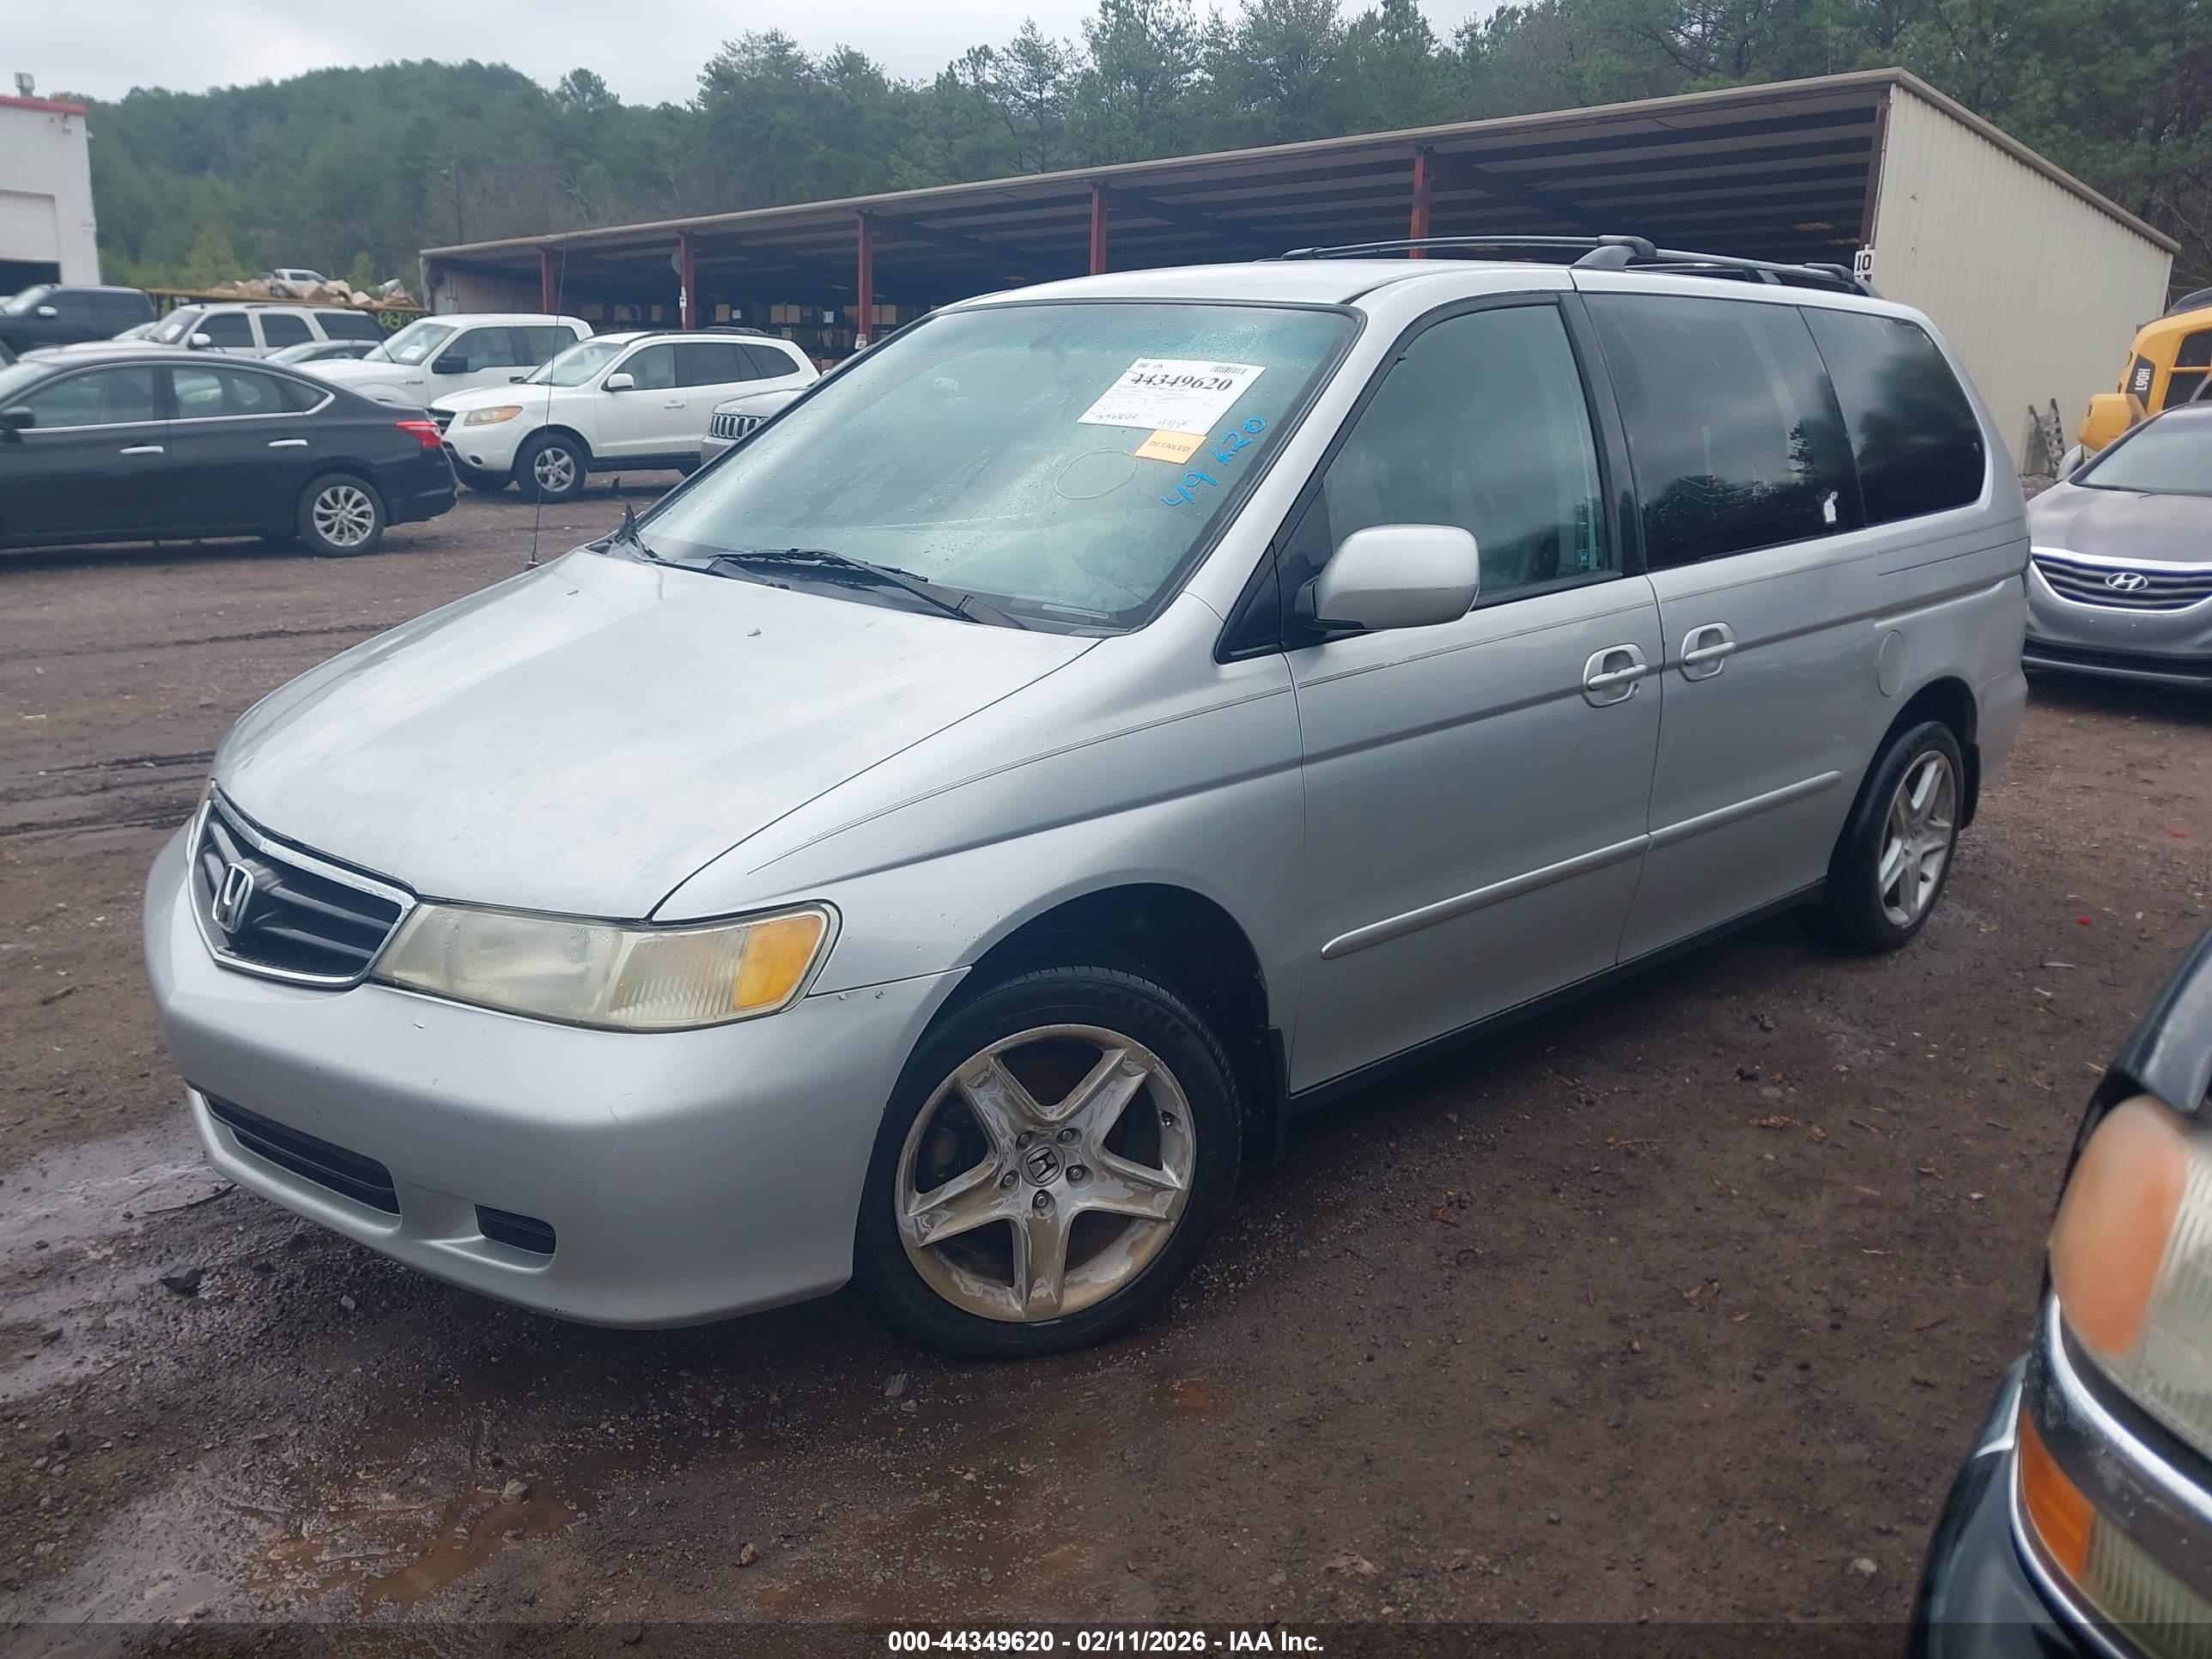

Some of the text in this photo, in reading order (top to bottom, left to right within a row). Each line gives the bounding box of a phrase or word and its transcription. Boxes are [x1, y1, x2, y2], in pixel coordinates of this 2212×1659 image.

[1856, 254, 1872, 270] 10
[1130, 373, 1233, 392] 44349620
[2135, 368, 2151, 391] L90H
[1147, 440, 1191, 453] DETAILED
[1161, 471, 1218, 506] 49
